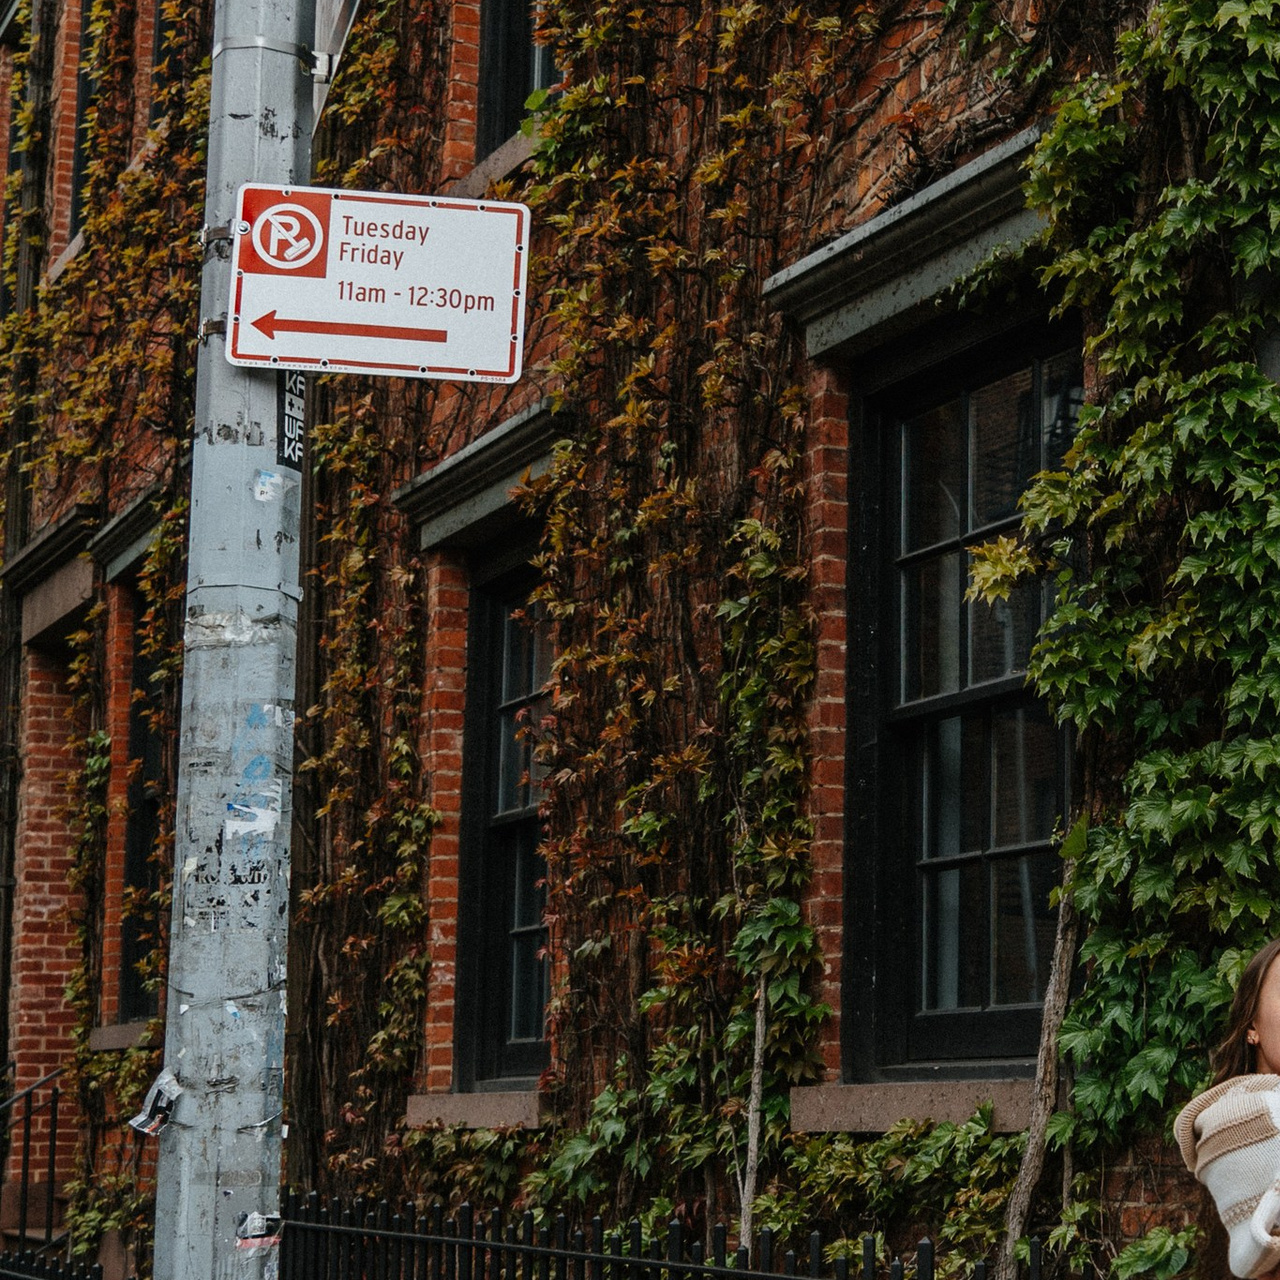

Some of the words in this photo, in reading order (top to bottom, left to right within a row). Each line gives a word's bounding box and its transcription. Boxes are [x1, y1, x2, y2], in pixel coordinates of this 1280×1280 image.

[342, 215, 430, 246] Tuesday
[339, 241, 405, 271] Friday
[338, 280, 386, 304] 11am
[408, 285, 495, 314] 12:30pm
